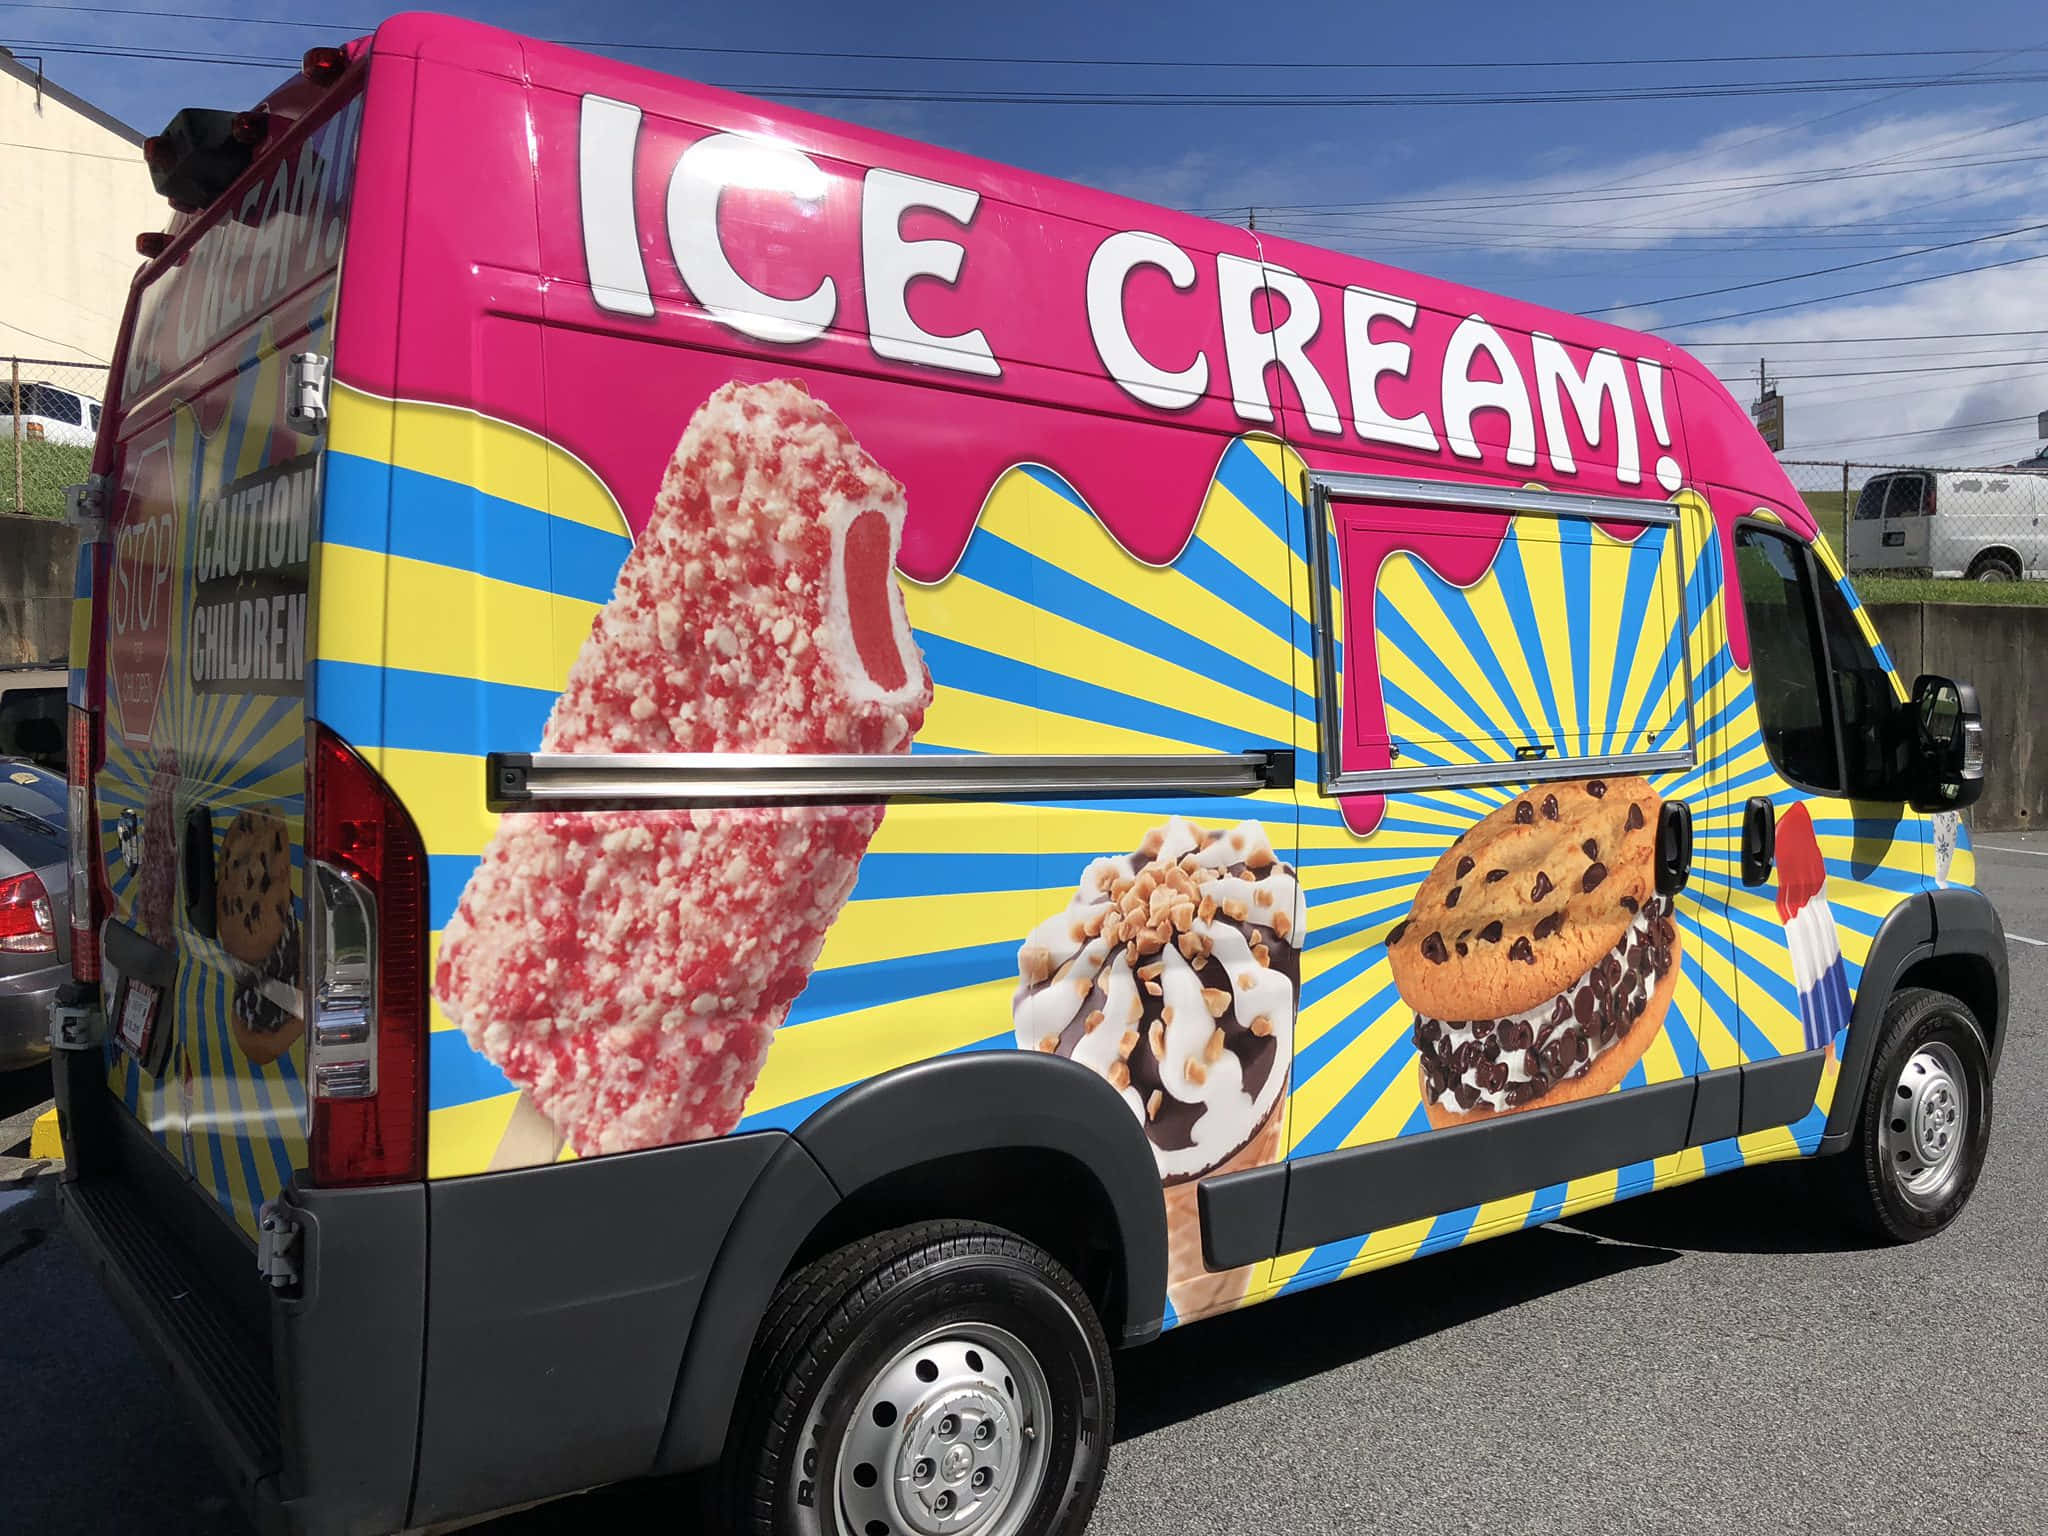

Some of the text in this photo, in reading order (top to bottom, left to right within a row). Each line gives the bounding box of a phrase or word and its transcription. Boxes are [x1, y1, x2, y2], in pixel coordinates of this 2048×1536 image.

[579, 93, 1684, 491] ICE CREAM!
[114, 513, 172, 635] STOP
[199, 468, 313, 583] CAUTION
[193, 593, 306, 682] CHILDREN
